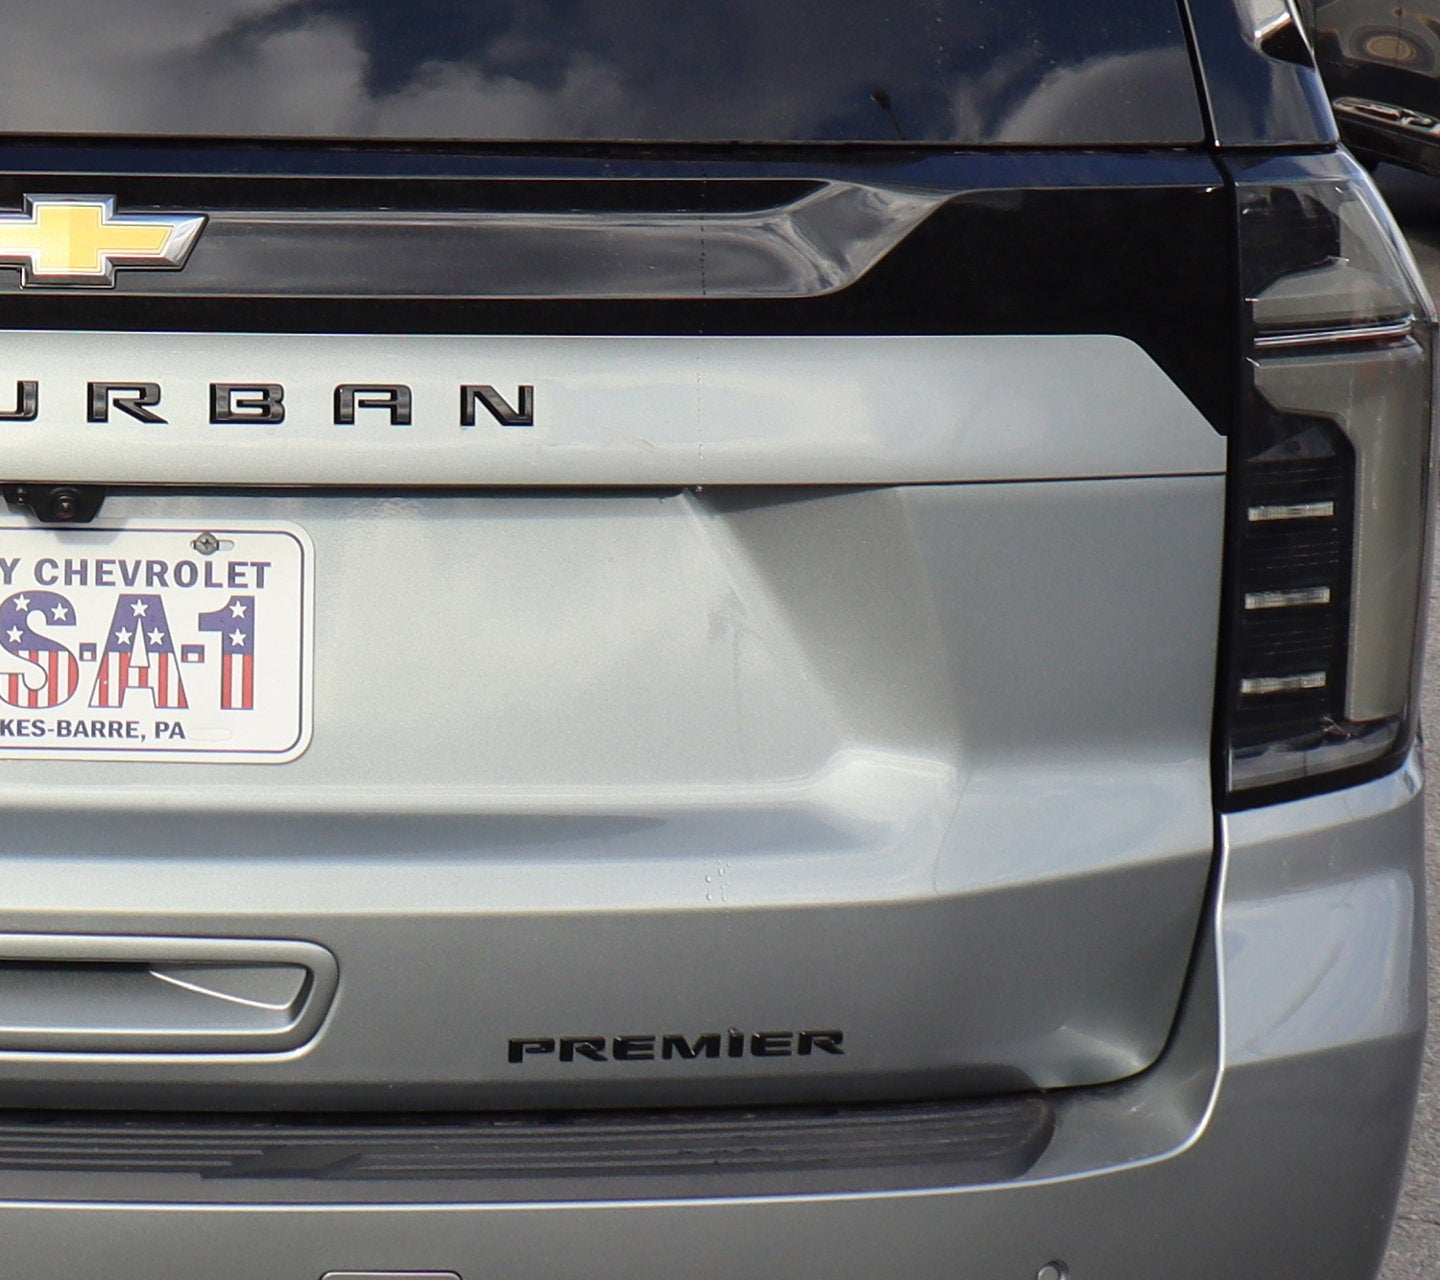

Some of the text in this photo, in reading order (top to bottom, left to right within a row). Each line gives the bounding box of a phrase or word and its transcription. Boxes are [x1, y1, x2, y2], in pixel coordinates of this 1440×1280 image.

[33, 557, 272, 590] CHEVROLET
[154, 720, 187, 740] PA
[507, 1025, 846, 1064] PREMIER
